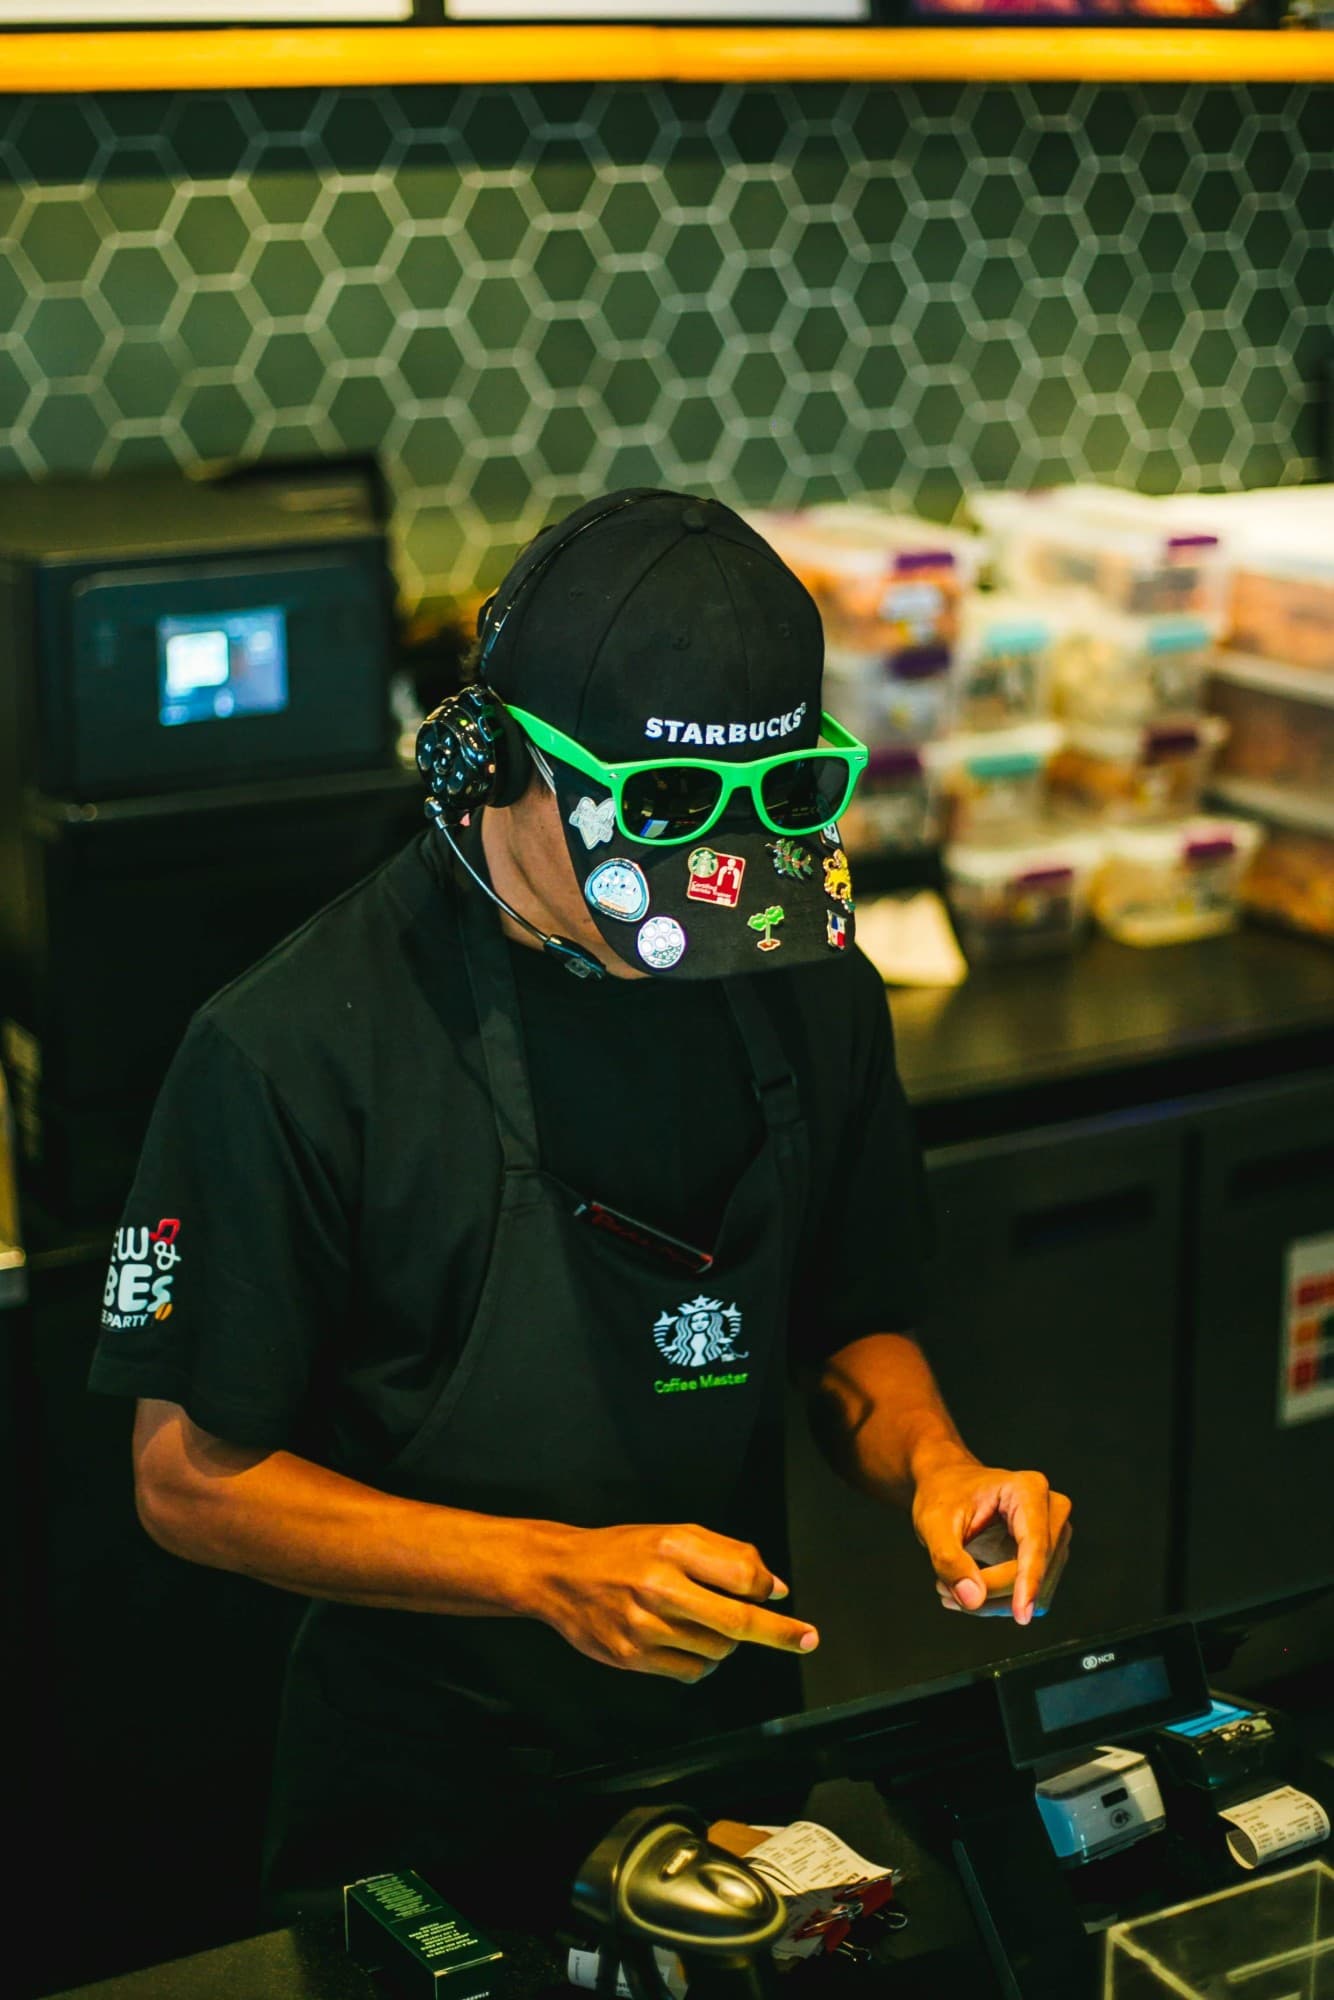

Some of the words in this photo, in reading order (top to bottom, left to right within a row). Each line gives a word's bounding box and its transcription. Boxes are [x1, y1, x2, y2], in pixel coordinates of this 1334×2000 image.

[653, 1377, 697, 1394] Coffee
[699, 1372, 749, 1388] Master
[1097, 1652, 1115, 1665] NCR
